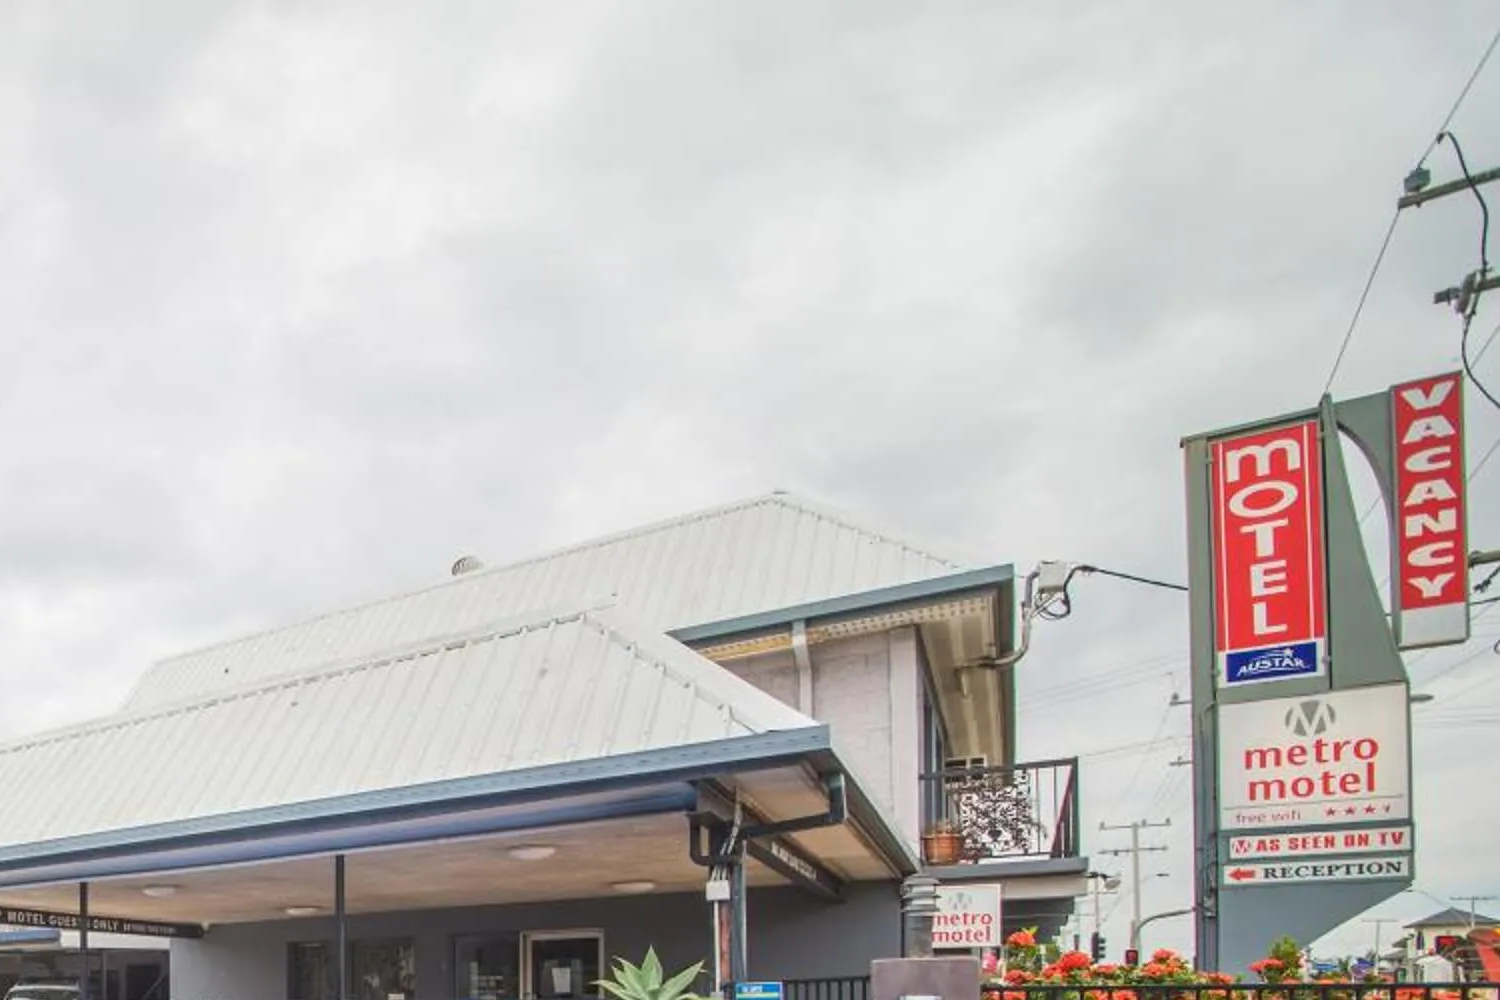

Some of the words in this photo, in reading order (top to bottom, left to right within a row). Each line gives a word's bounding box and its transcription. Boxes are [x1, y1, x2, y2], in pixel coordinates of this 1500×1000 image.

[1400, 381, 1457, 599] VACANCY
[1225, 437, 1301, 636] MOTEL
[1236, 657, 1306, 679] AUSTAR
[1245, 736, 1379, 770] metro
[1248, 762, 1375, 801] motel
[1255, 839, 1280, 852] AS
[1288, 836, 1335, 850] SEEN
[1344, 834, 1369, 847] ON
[1379, 831, 1404, 845] TV
[1263, 861, 1402, 880] RECEPTION
[7, 911, 46, 925] MOTEL
[93, 919, 118, 932] ONLY
[932, 926, 991, 942] motel
